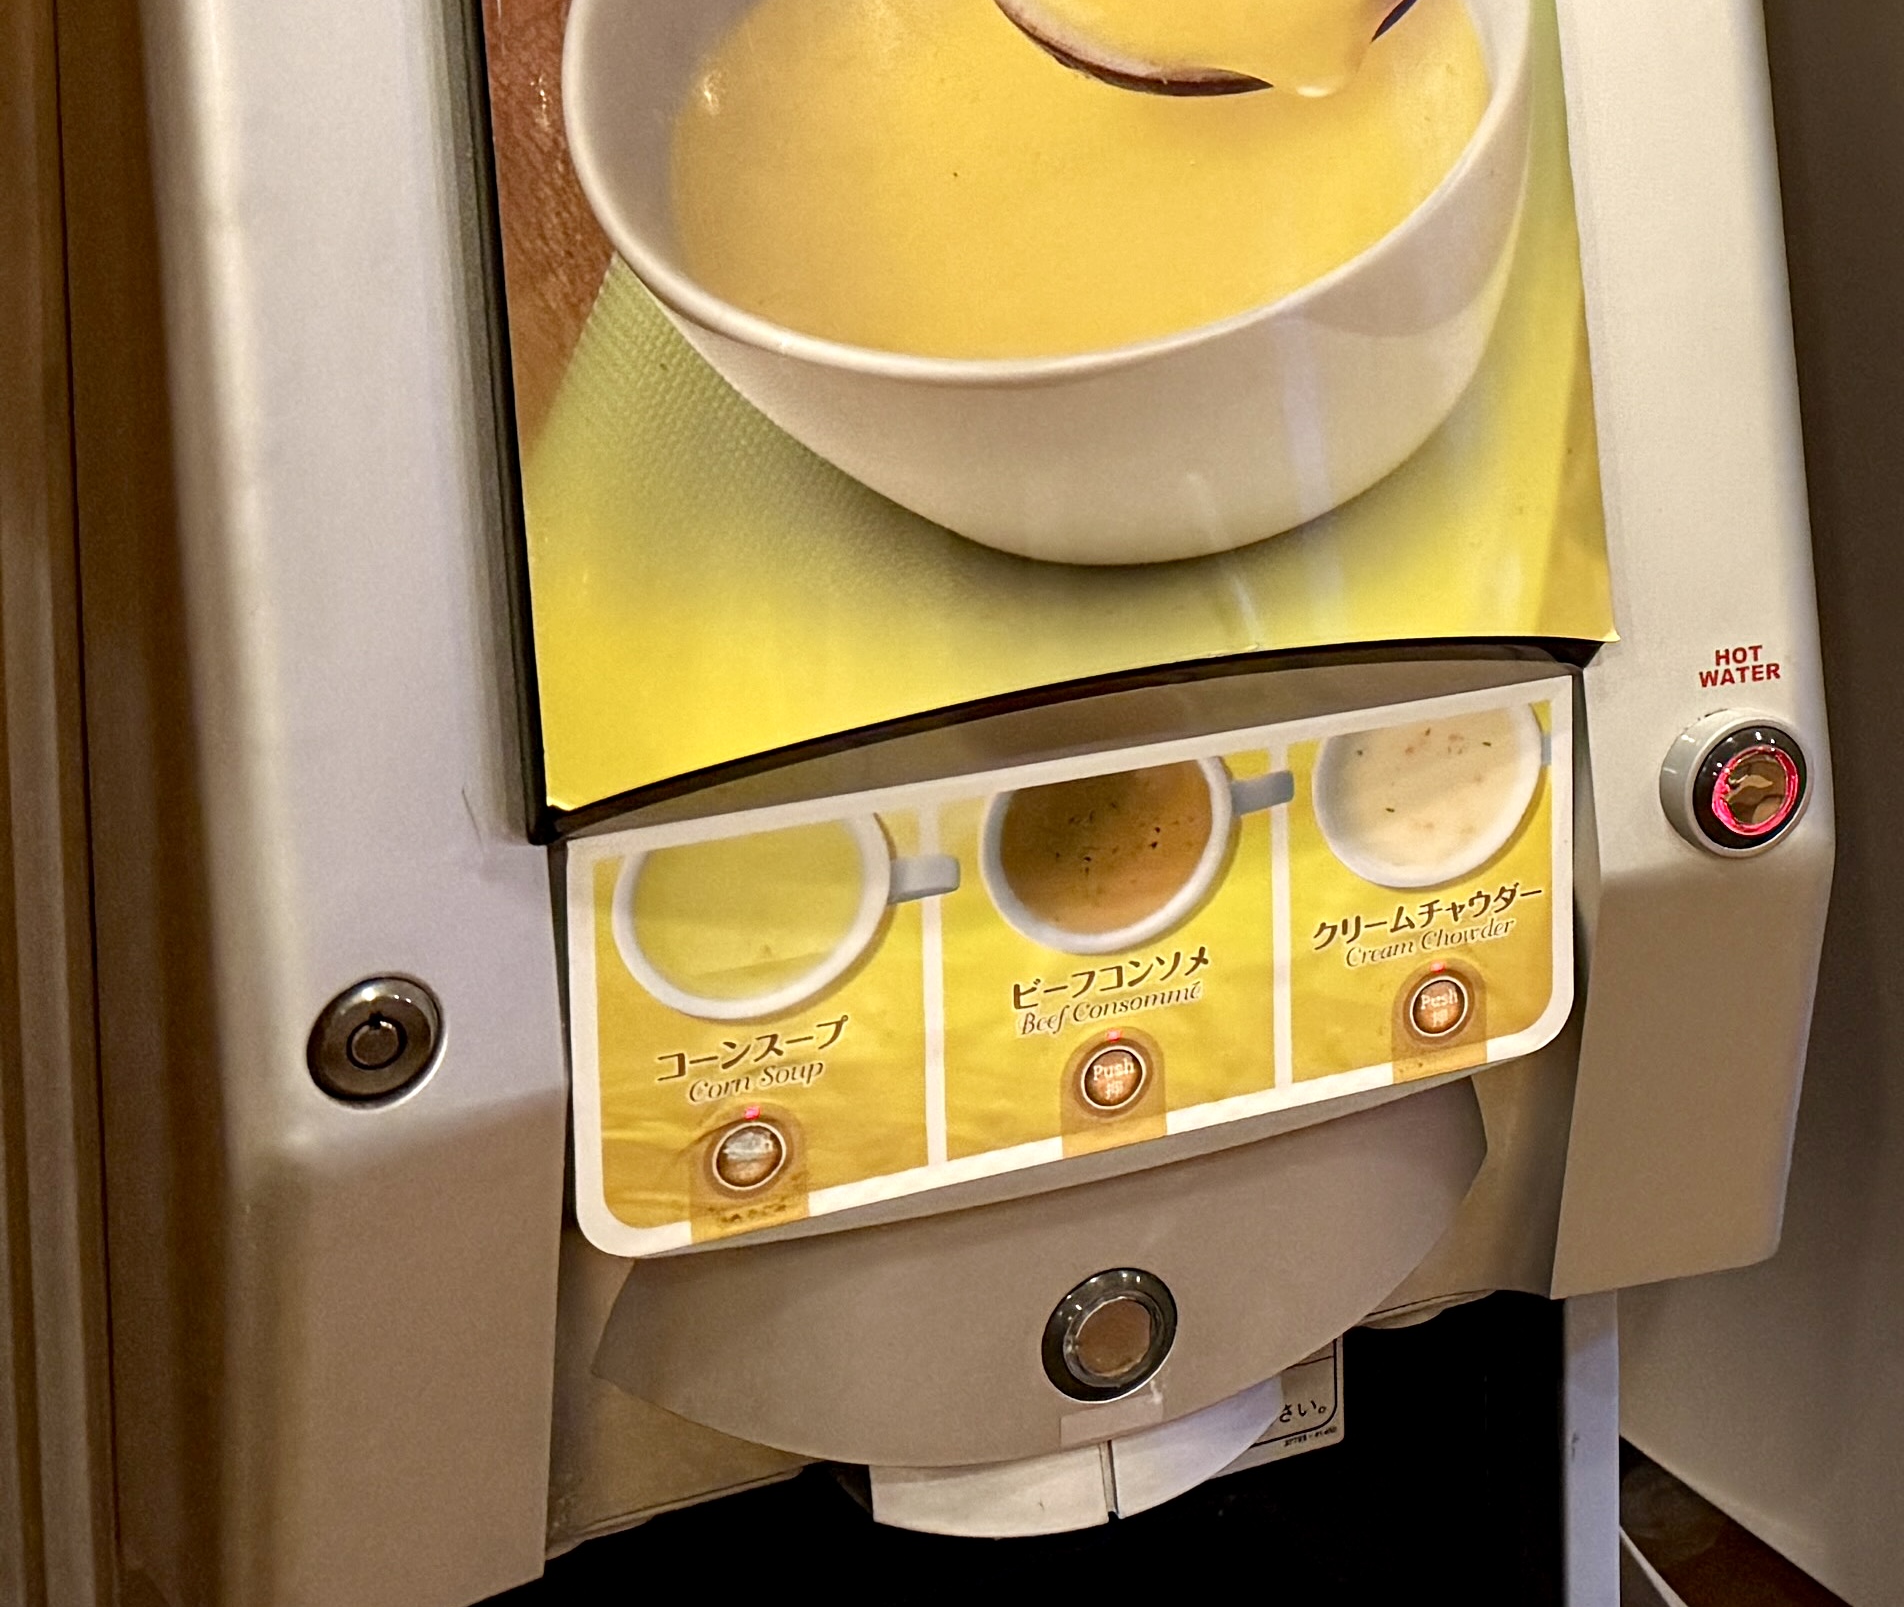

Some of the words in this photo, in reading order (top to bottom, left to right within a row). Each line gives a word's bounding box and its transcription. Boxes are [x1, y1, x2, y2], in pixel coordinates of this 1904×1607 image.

[1698, 662, 1781, 689] WATER
[1714, 644, 1763, 667] HOT
[1312, 882, 1544, 952] クリームチャウダー
[1345, 936, 1415, 969] Cream
[1420, 915, 1515, 952] Chowder
[1012, 945, 1210, 1011] ビーフコンソメ
[1020, 1004, 1069, 1038] Beef
[656, 1014, 849, 1084] コーンスープ
[1093, 1057, 1135, 1082] Push
[688, 1072, 752, 1104] Corn
[758, 1058, 825, 1088] Soup
